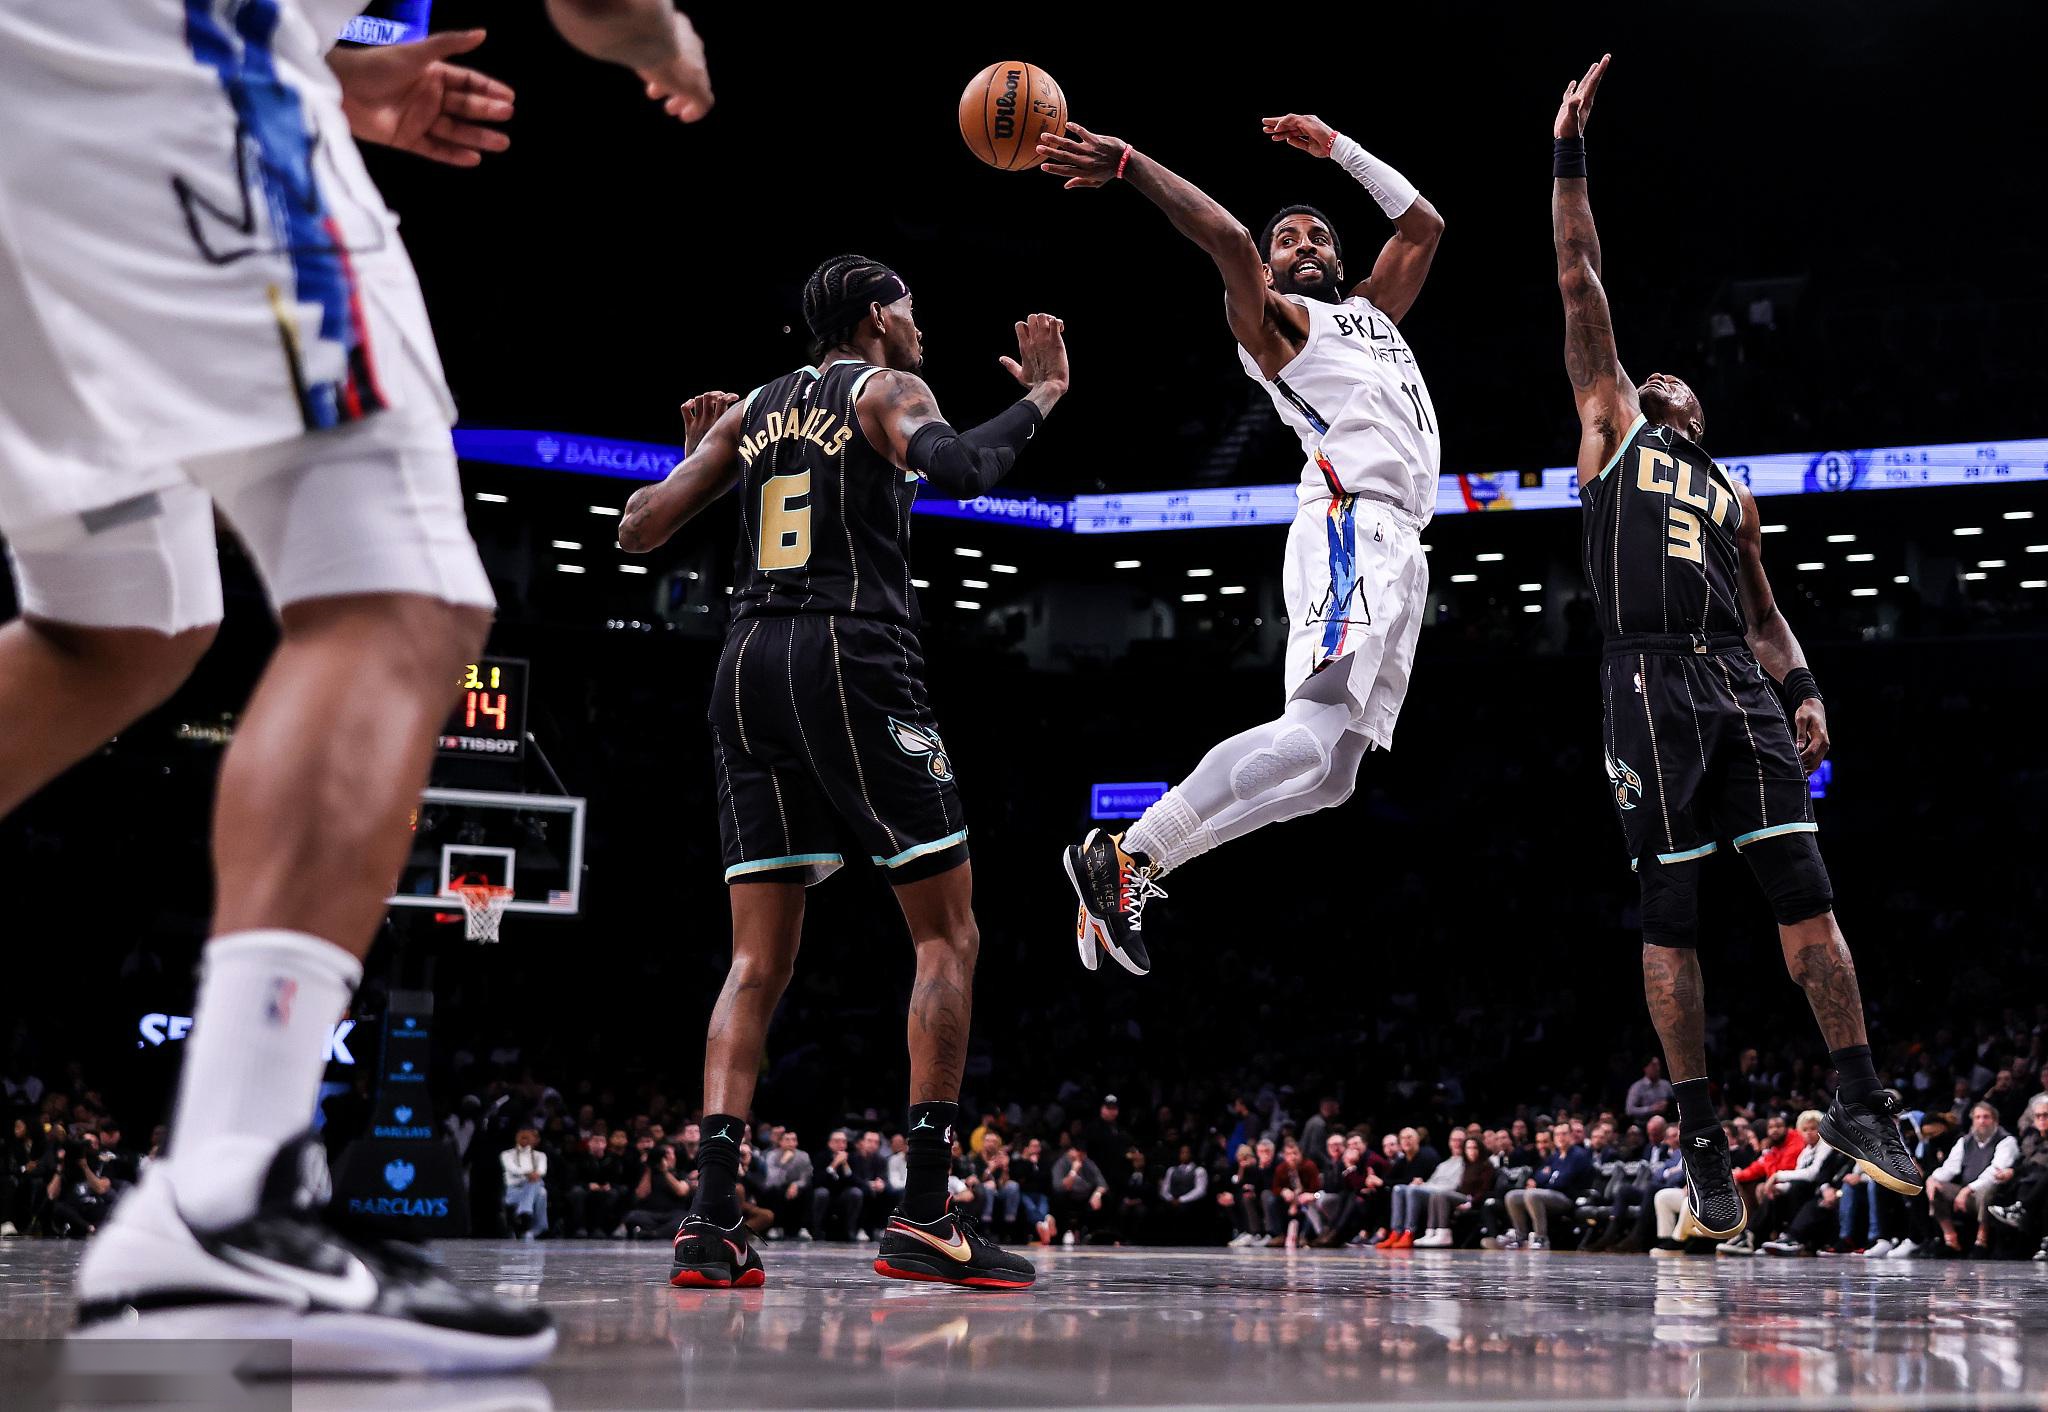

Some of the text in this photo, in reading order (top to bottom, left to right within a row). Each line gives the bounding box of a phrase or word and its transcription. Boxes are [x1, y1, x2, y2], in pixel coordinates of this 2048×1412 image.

[995, 70, 1021, 139] Wilson
[1400, 382, 1433, 434] 11
[565, 442, 677, 474] BARCLAYS
[1726, 464, 1750, 488] 3
[1636, 445, 1734, 527] CLT
[757, 468, 812, 571] 6
[1667, 507, 1703, 564] 3
[465, 691, 507, 730] 14
[460, 738, 519, 753] TISSOT
[374, 1126, 432, 1139] BARCLAYS
[350, 1198, 449, 1216] BARCLAYS
